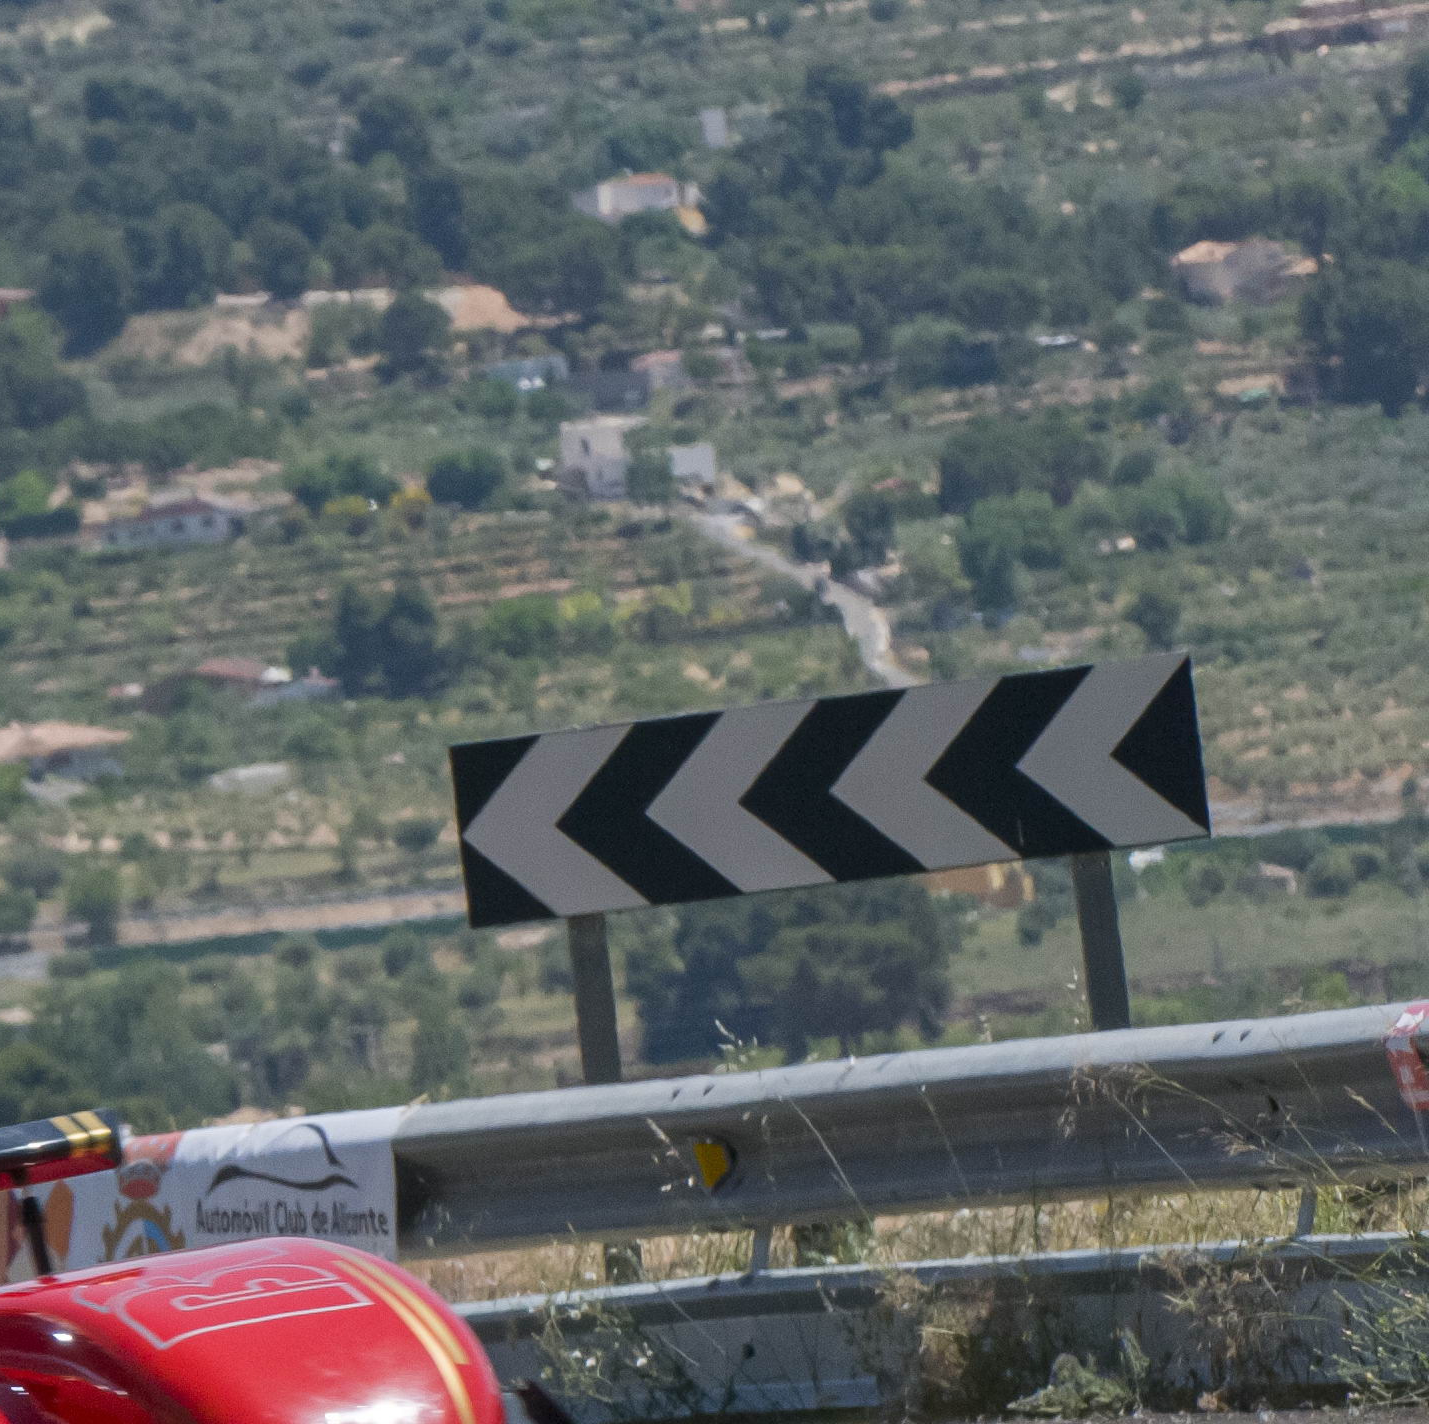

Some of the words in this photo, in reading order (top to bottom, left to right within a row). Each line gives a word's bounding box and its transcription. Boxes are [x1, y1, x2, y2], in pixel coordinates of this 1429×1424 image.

[274, 1199, 308, 1235] Club
[310, 1201, 328, 1235] de
[332, 1199, 390, 1236] Alicante
